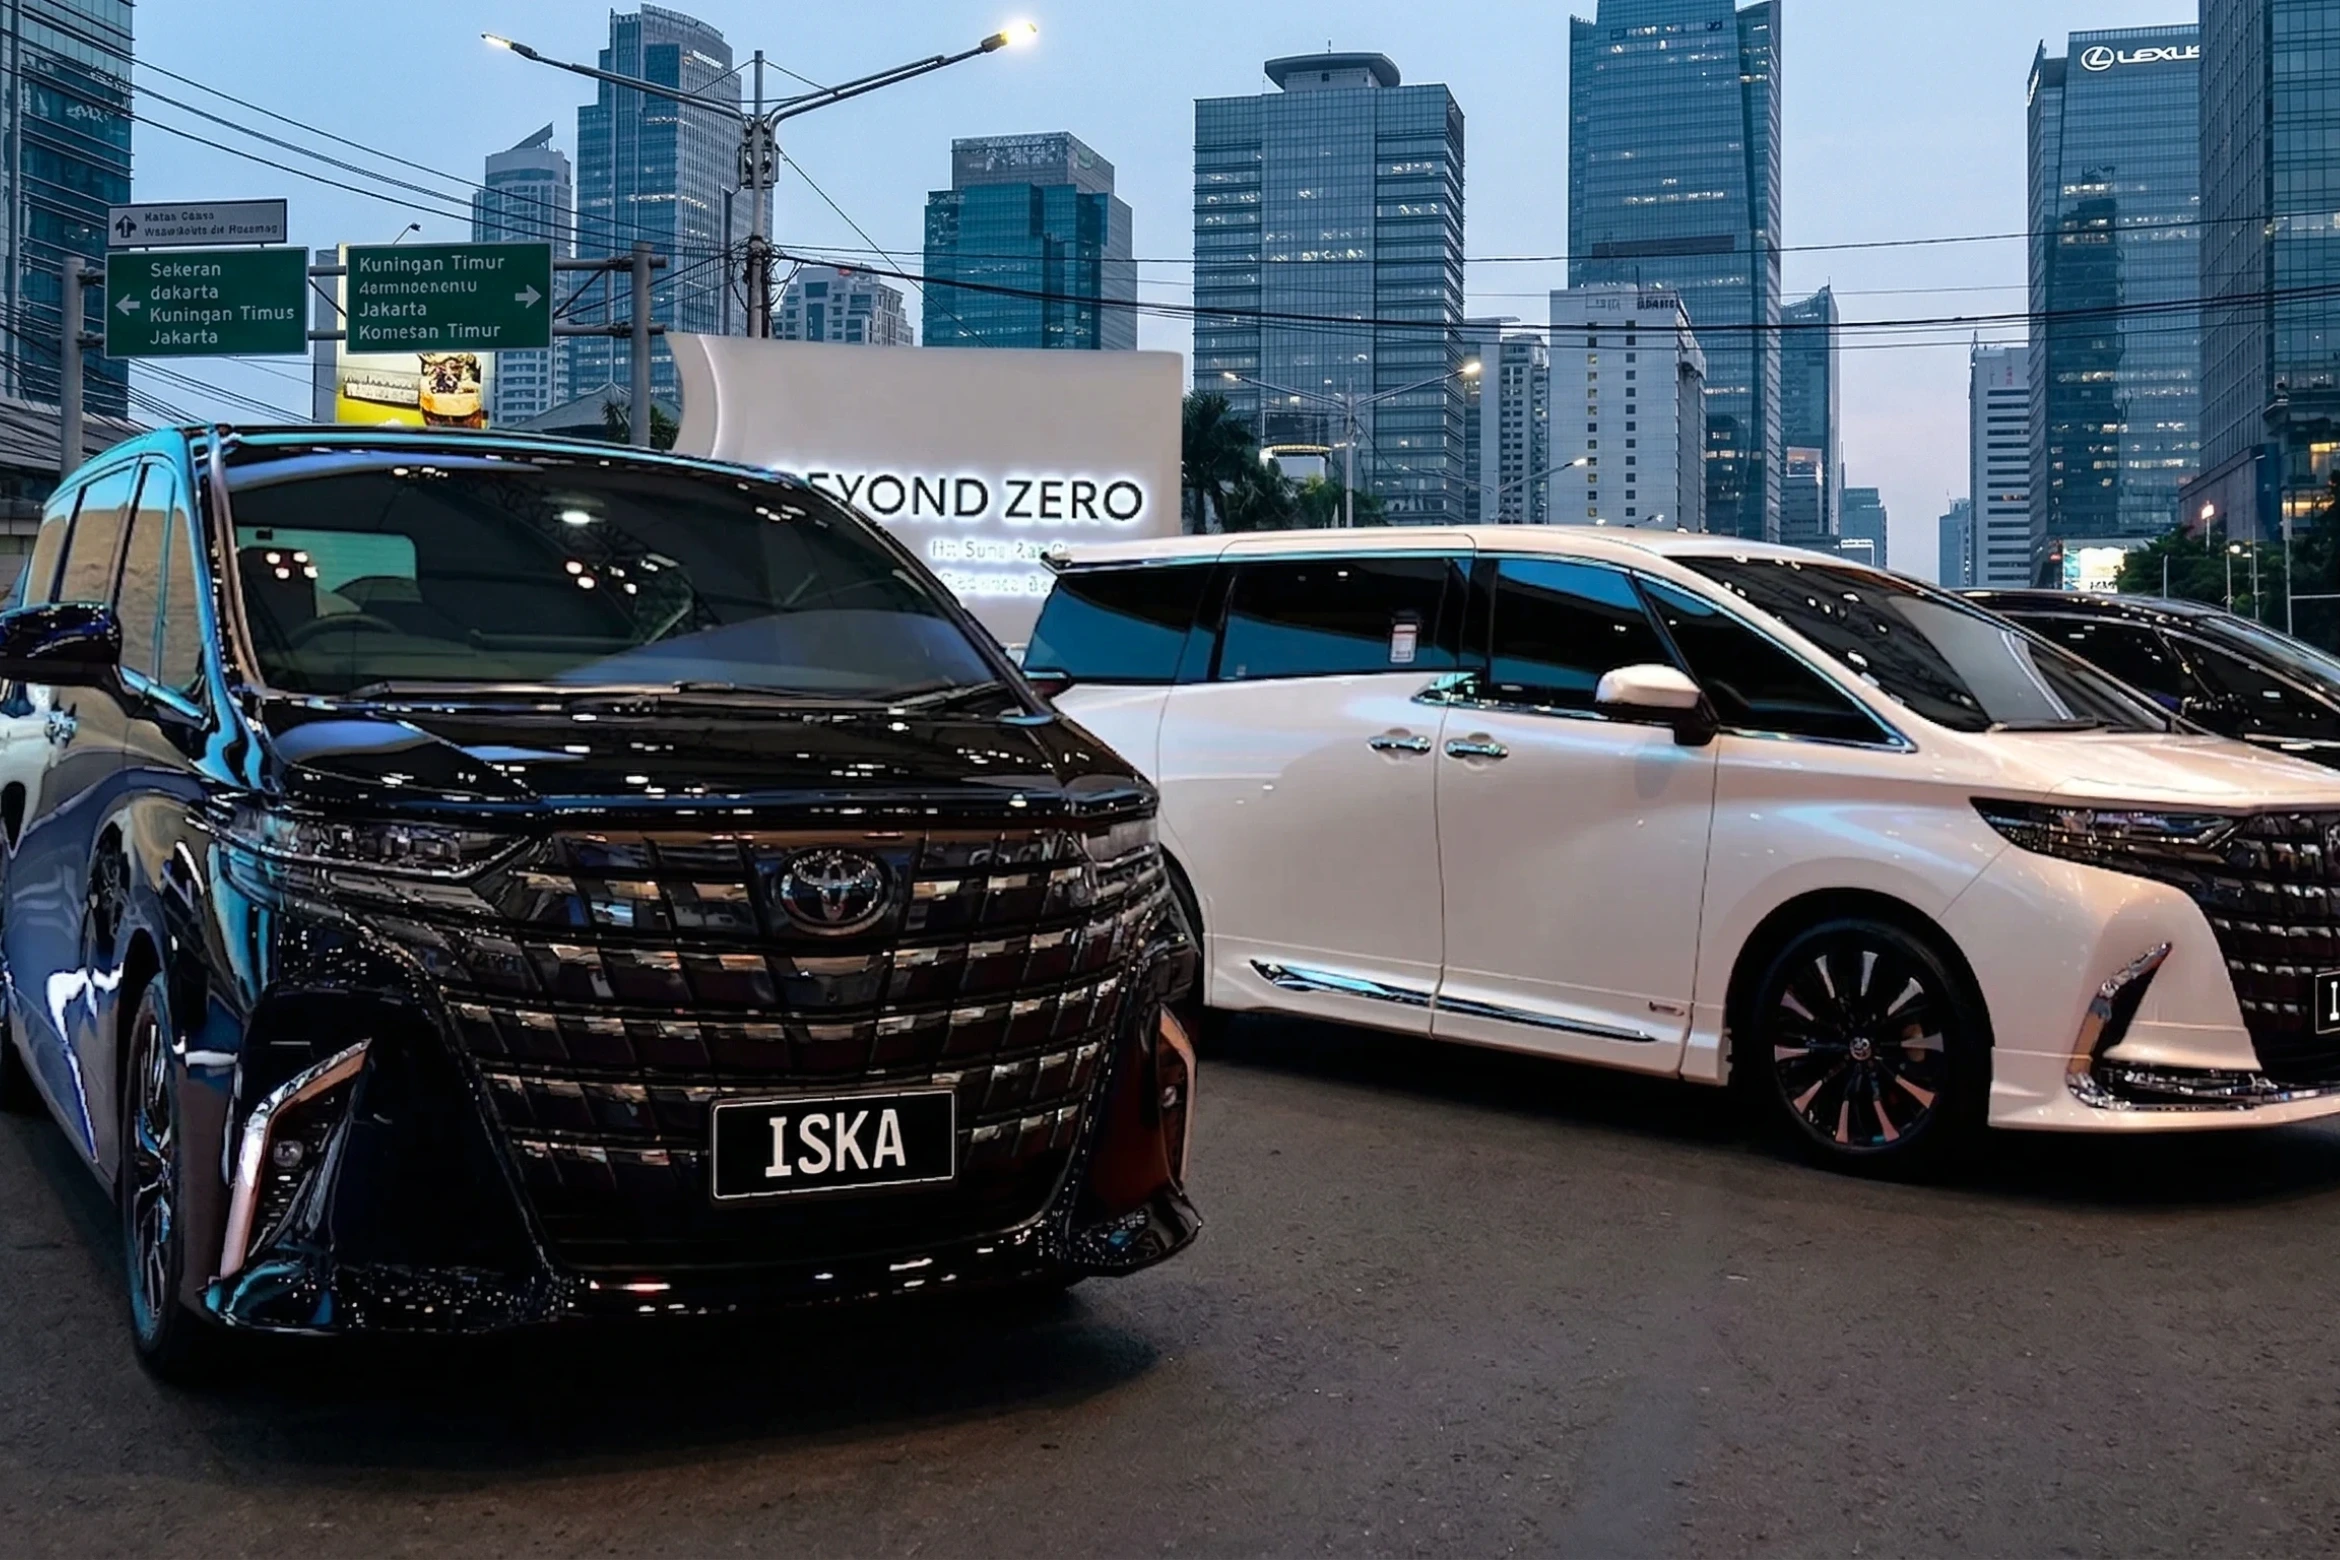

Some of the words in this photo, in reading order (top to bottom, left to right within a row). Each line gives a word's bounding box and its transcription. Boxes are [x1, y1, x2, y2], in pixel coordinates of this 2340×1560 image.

[150, 262, 222, 277] Sekeran
[359, 256, 444, 276] Kuningan
[451, 255, 506, 271] Timur
[150, 307, 233, 326] Kuningan
[240, 305, 295, 321] Timus
[359, 302, 427, 317] Jakarta
[150, 329, 219, 345] Jakarta
[447, 323, 502, 338] Timur
[1004, 479, 1144, 522] ZERO
[764, 1108, 907, 1178] ISKA
